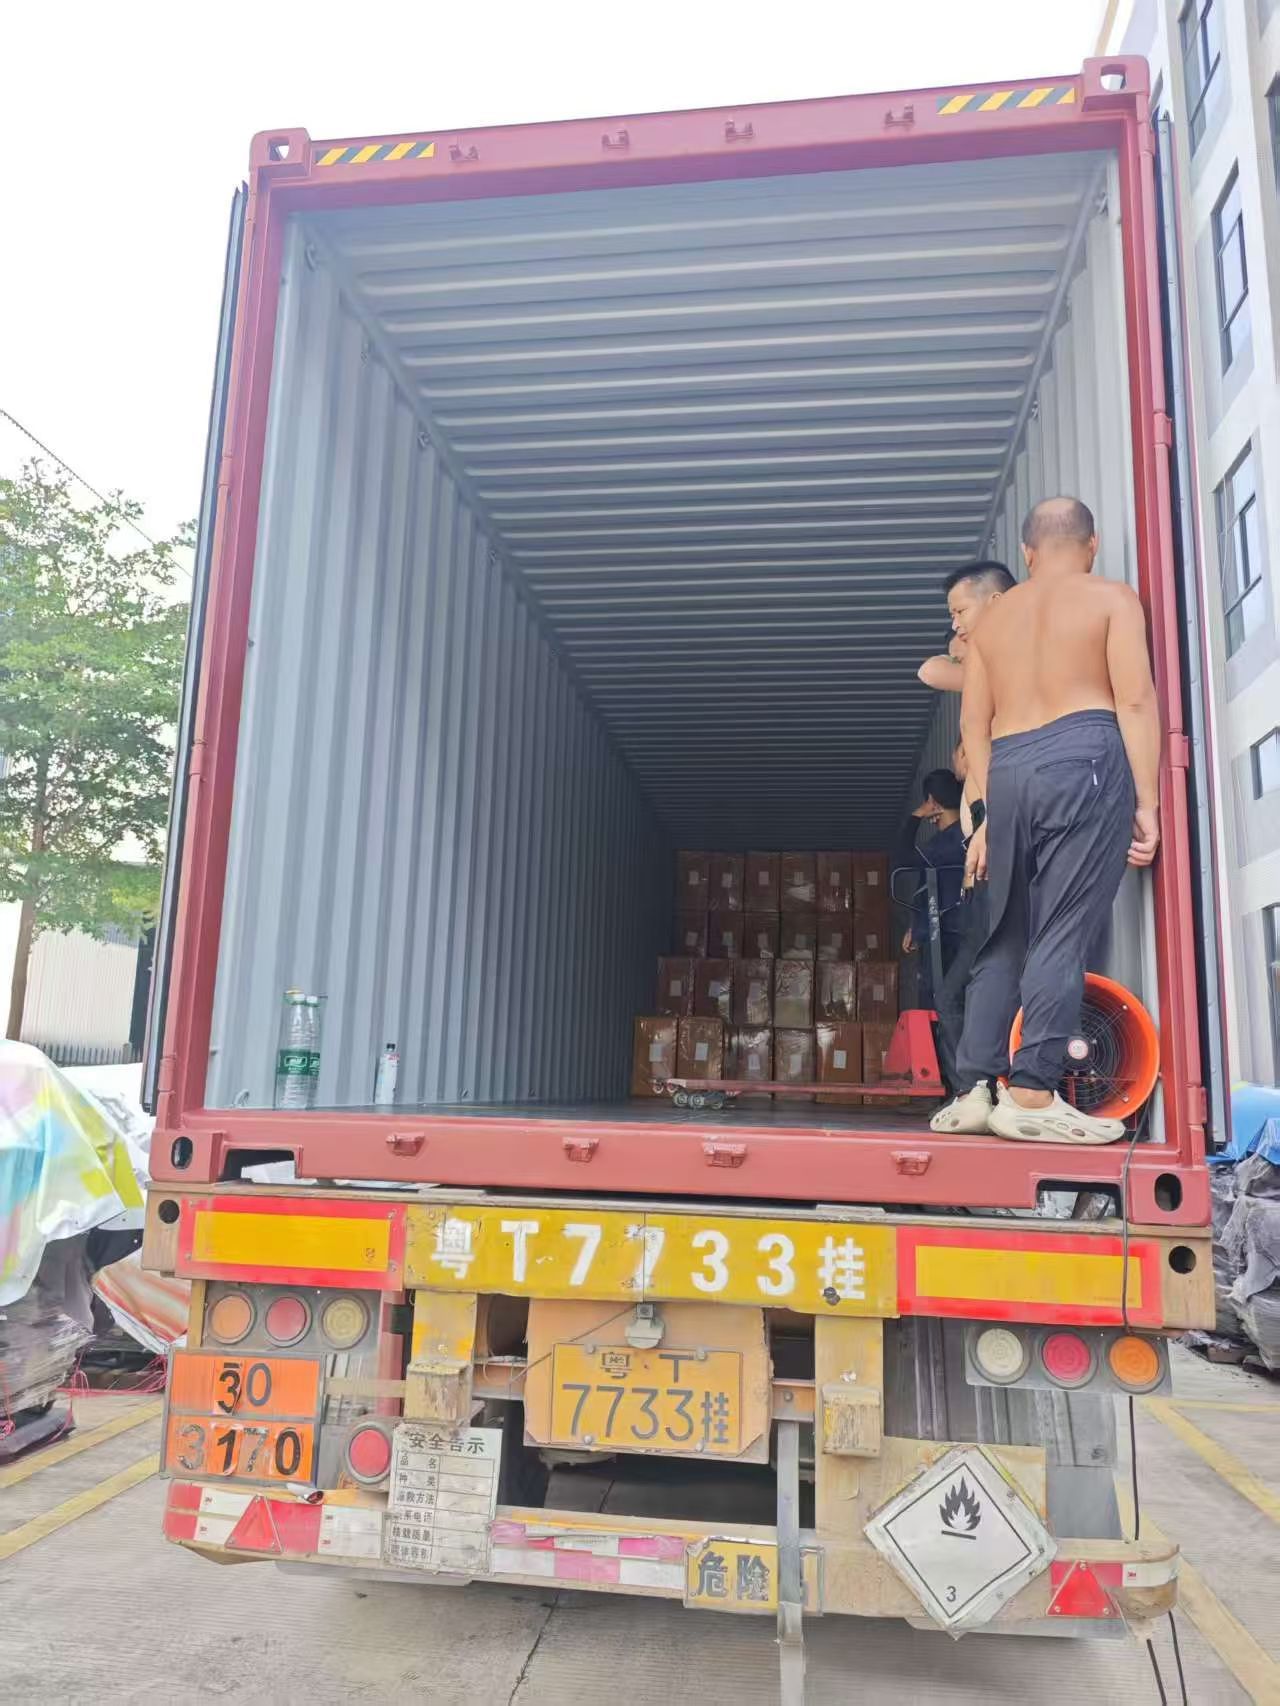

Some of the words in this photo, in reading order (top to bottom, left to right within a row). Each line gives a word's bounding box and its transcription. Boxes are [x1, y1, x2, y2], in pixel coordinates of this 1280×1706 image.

[217, 1362, 272, 1413] 30
[563, 1383, 729, 1443] 7733挂
[177, 1423, 301, 1475] 3170
[409, 1433, 485, 1454] 安全告示
[697, 1551, 808, 1605] 危险
[946, 1585, 957, 1602] 3
